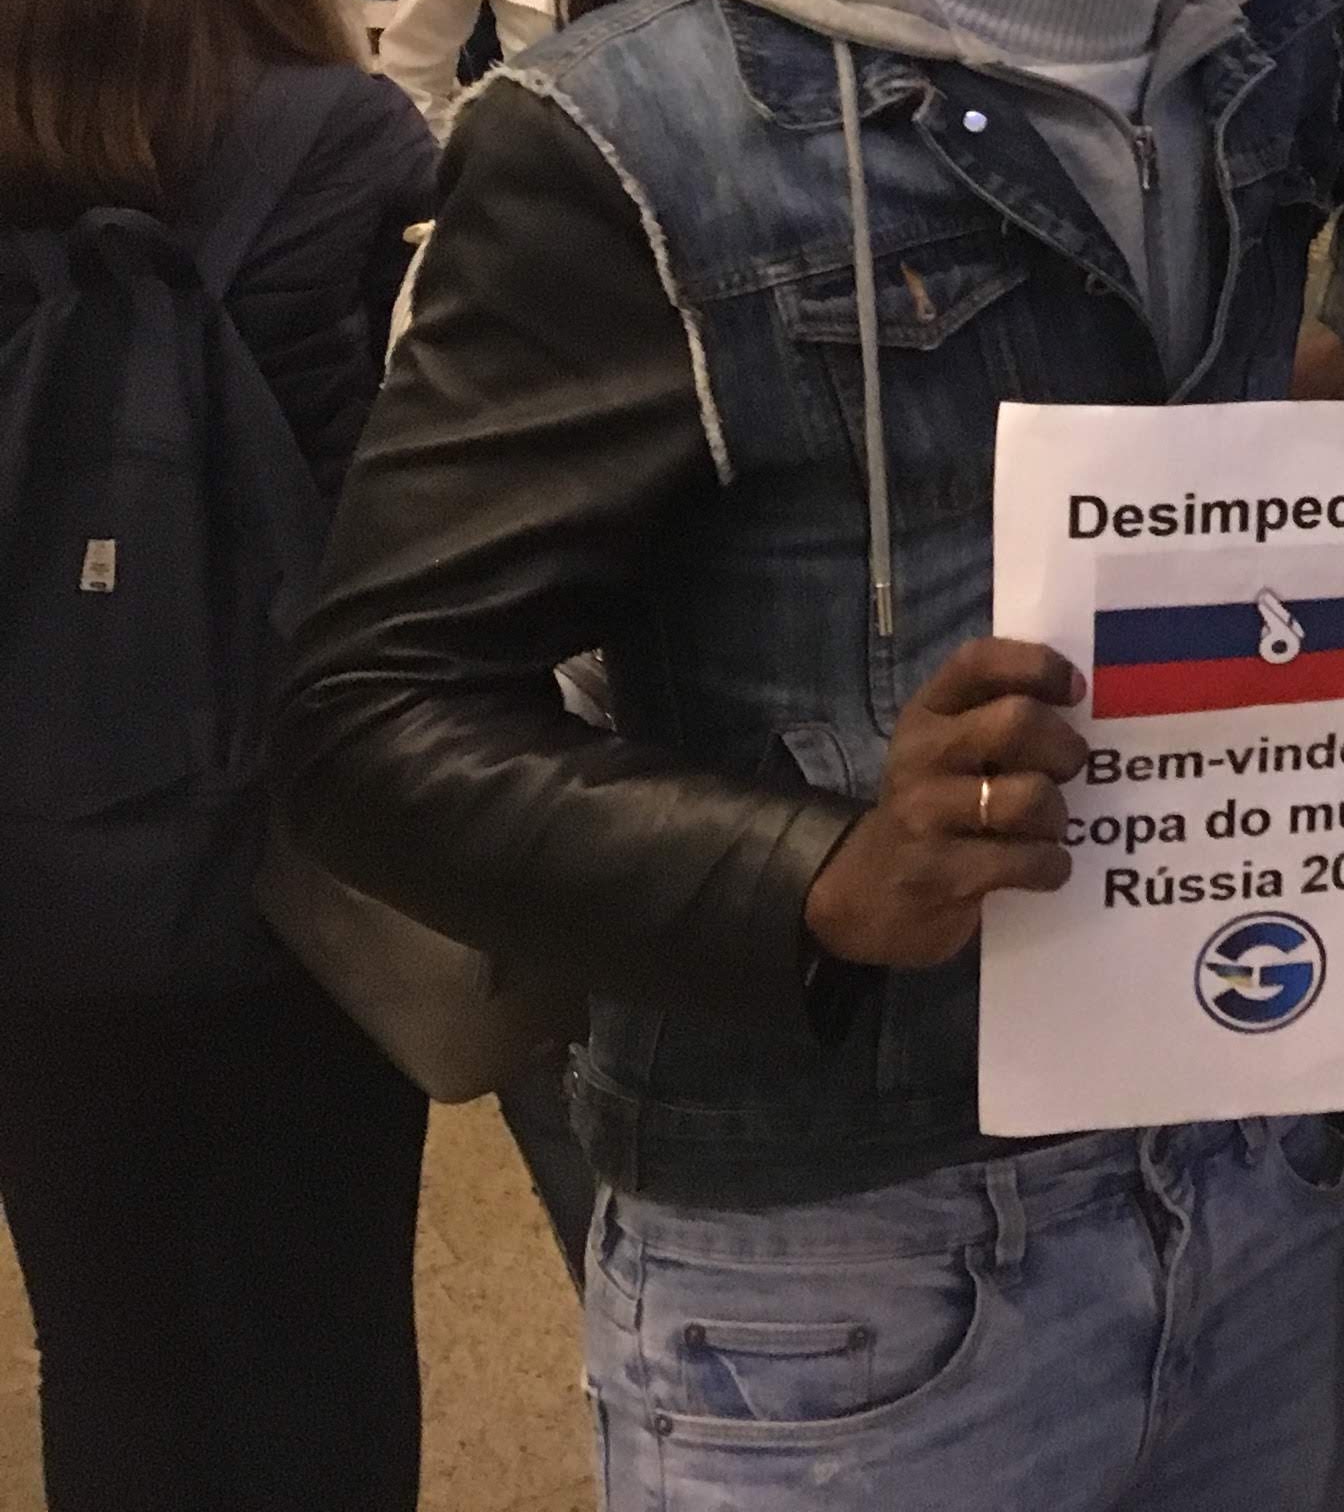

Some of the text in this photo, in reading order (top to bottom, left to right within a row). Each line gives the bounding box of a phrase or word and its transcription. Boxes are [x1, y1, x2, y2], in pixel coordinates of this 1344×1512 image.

[1061, 813, 1187, 856] copa
[1205, 798, 1271, 840] do
[1103, 859, 1283, 909] Rússia
